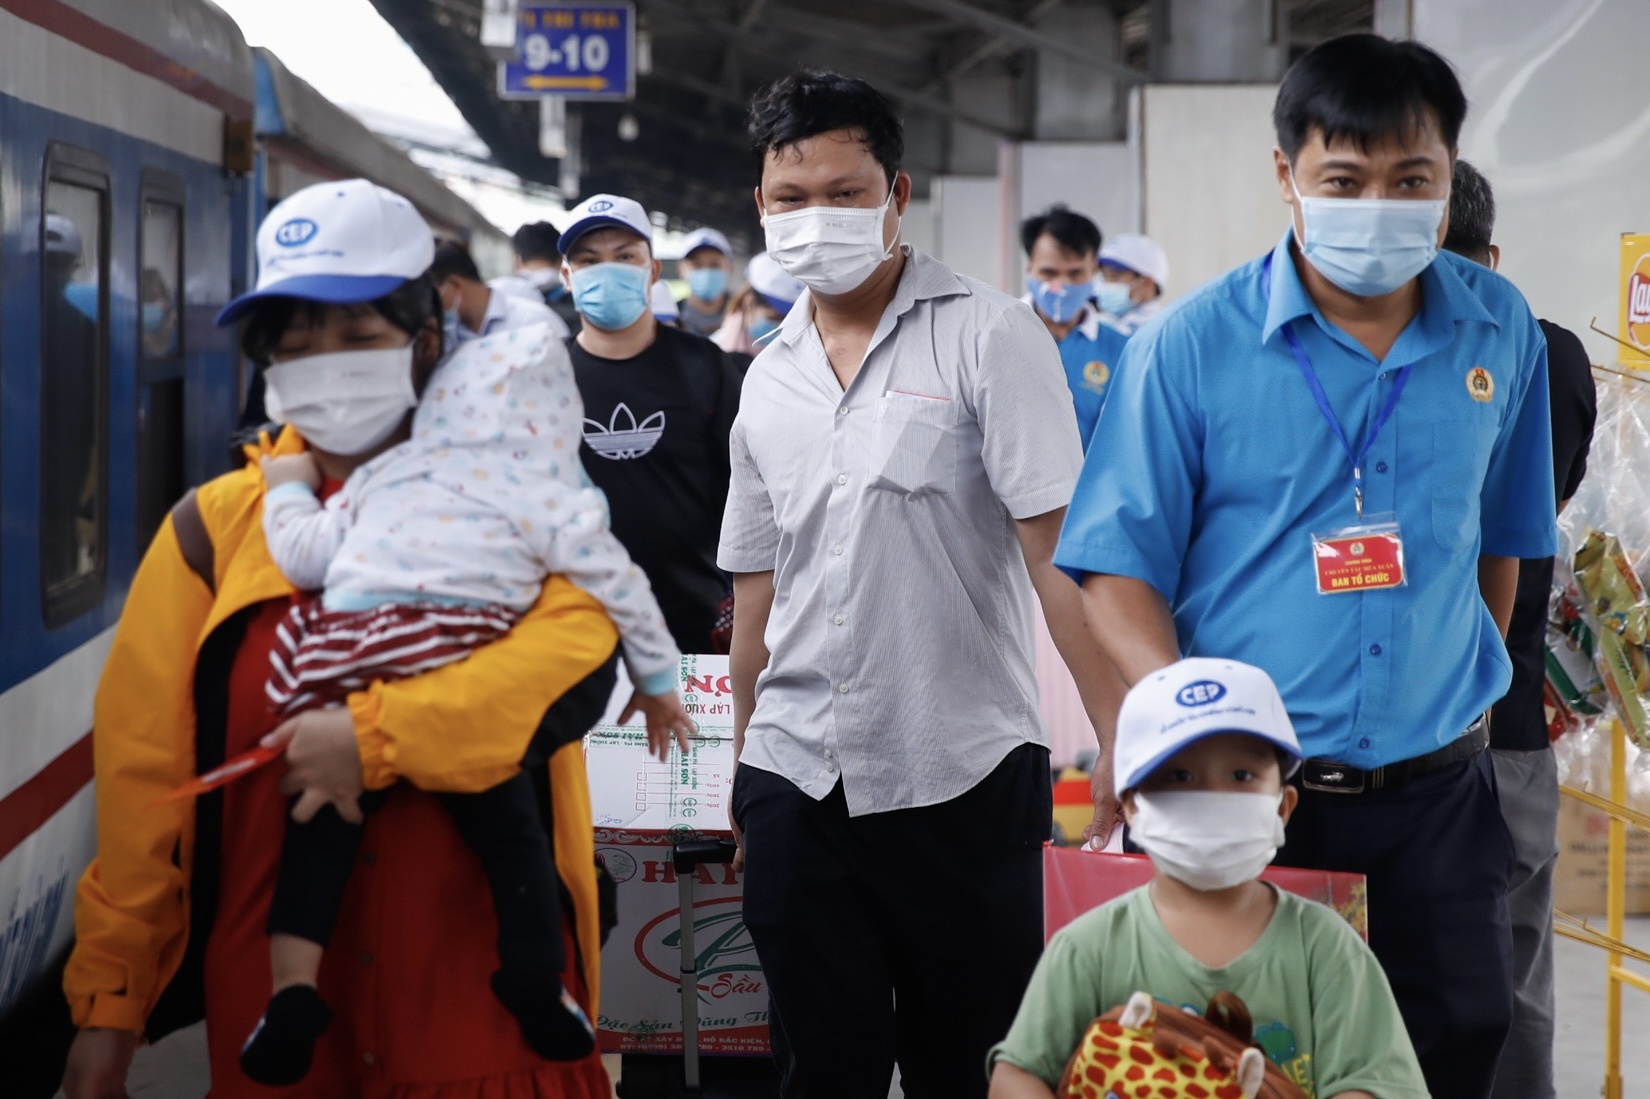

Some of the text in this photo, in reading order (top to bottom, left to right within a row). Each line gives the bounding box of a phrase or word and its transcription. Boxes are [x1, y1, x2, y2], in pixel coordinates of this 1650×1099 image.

[525, 33, 609, 72] 9-10
[1331, 578, 1350, 587] BAN
[1181, 683, 1220, 706] CEP
